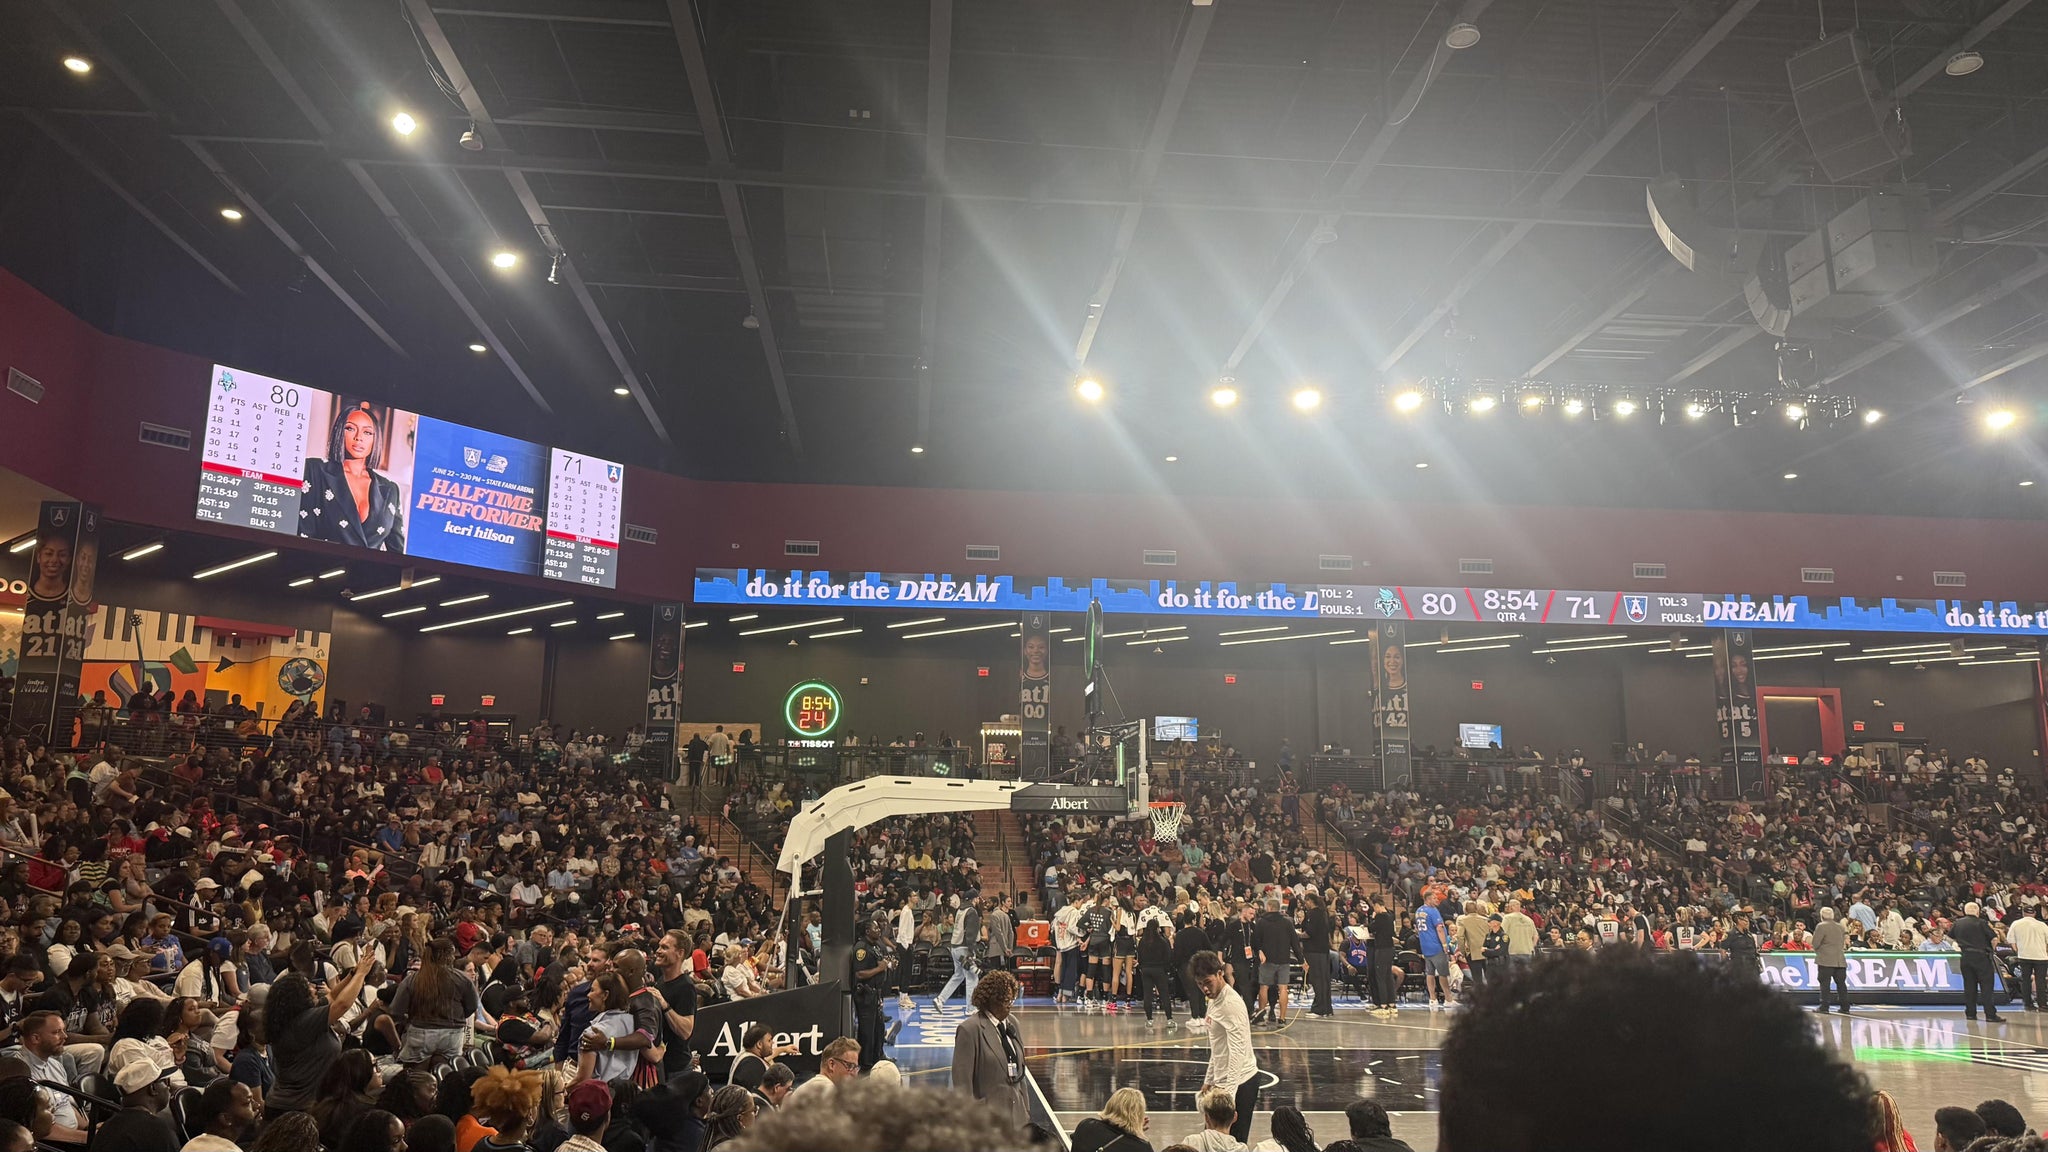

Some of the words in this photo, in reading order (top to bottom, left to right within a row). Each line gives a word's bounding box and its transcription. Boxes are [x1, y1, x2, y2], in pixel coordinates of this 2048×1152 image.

[270, 385, 299, 407] 80
[213, 404, 224, 412] 13
[230, 397, 245, 406] PTS
[252, 402, 267, 411] AST
[274, 407, 290, 416] REB
[211, 415, 223, 423] 18
[230, 419, 240, 427] 11
[210, 426, 221, 435] 23
[228, 430, 239, 438] 17
[208, 438, 220, 446] 30
[227, 442, 238, 450] 15
[207, 449, 219, 458] 35
[225, 453, 237, 461] 11
[270, 462, 281, 470] 10
[563, 455, 581, 475] 71
[202, 472, 215, 481] FG:
[216, 475, 241, 486] 26-47
[240, 469, 262, 480] TEAM
[200, 484, 212, 493] FT:
[213, 487, 238, 498] 15-19
[254, 482, 271, 492] 3PT:
[272, 485, 295, 496] 13-23
[430, 478, 533, 512] HALFTIME
[199, 497, 217, 507] AST:
[218, 500, 229, 509] 19
[252, 494, 265, 503] TO:
[266, 497, 277, 505] 15
[198, 508, 215, 518] STL:
[251, 506, 270, 516] REB:
[270, 510, 282, 518] 34
[416, 493, 543, 531] PERFORMER
[250, 518, 268, 527] BLK:
[444, 521, 473, 536] keri
[473, 525, 515, 544] hilson
[746, 577, 778, 598] do
[783, 577, 803, 598] it
[807, 578, 845, 599] for
[850, 579, 890, 600] the
[896, 580, 1000, 602] DREAM
[1320, 589, 1341, 598] TOL:
[1346, 590, 1353, 598] 2
[1158, 588, 1189, 609] do
[1194, 588, 1211, 608] it
[1216, 589, 1251, 610] for
[1257, 590, 1297, 610] the
[1421, 593, 1456, 616] 80
[1483, 590, 1539, 612] 8:54
[1658, 597, 1679, 606] TOL:
[1680, 598, 1687, 606] 3
[1321, 605, 1354, 614] FOULS:
[1356, 606, 1363, 615] 1
[1566, 597, 1601, 618] 71
[1703, 600, 1797, 622] DREAM
[1497, 612, 1516, 622] QTR
[1518, 612, 1526, 622] 4
[1662, 613, 1694, 622] FOULS:
[1696, 615, 1703, 623] 1
[1945, 607, 1974, 627] do
[1978, 608, 1996, 627] it
[1999, 608, 2033, 628] for
[26, 636, 56, 656] 21
[648, 683, 679, 703] atl
[1021, 686, 1049, 703] atl
[802, 696, 831, 710] 8:54
[1024, 704, 1045, 718] 00
[800, 711, 825, 728] 24
[1386, 713, 1407, 727] 42
[1722, 722, 1728, 737] 5
[1741, 721, 1751, 737] 5
[1050, 797, 1088, 809] Albert
[1028, 926, 1038, 938] G
[1417, 919, 1427, 931] 25
[1682, 929, 1690, 938] 28
[707, 1020, 824, 1057] Alert
